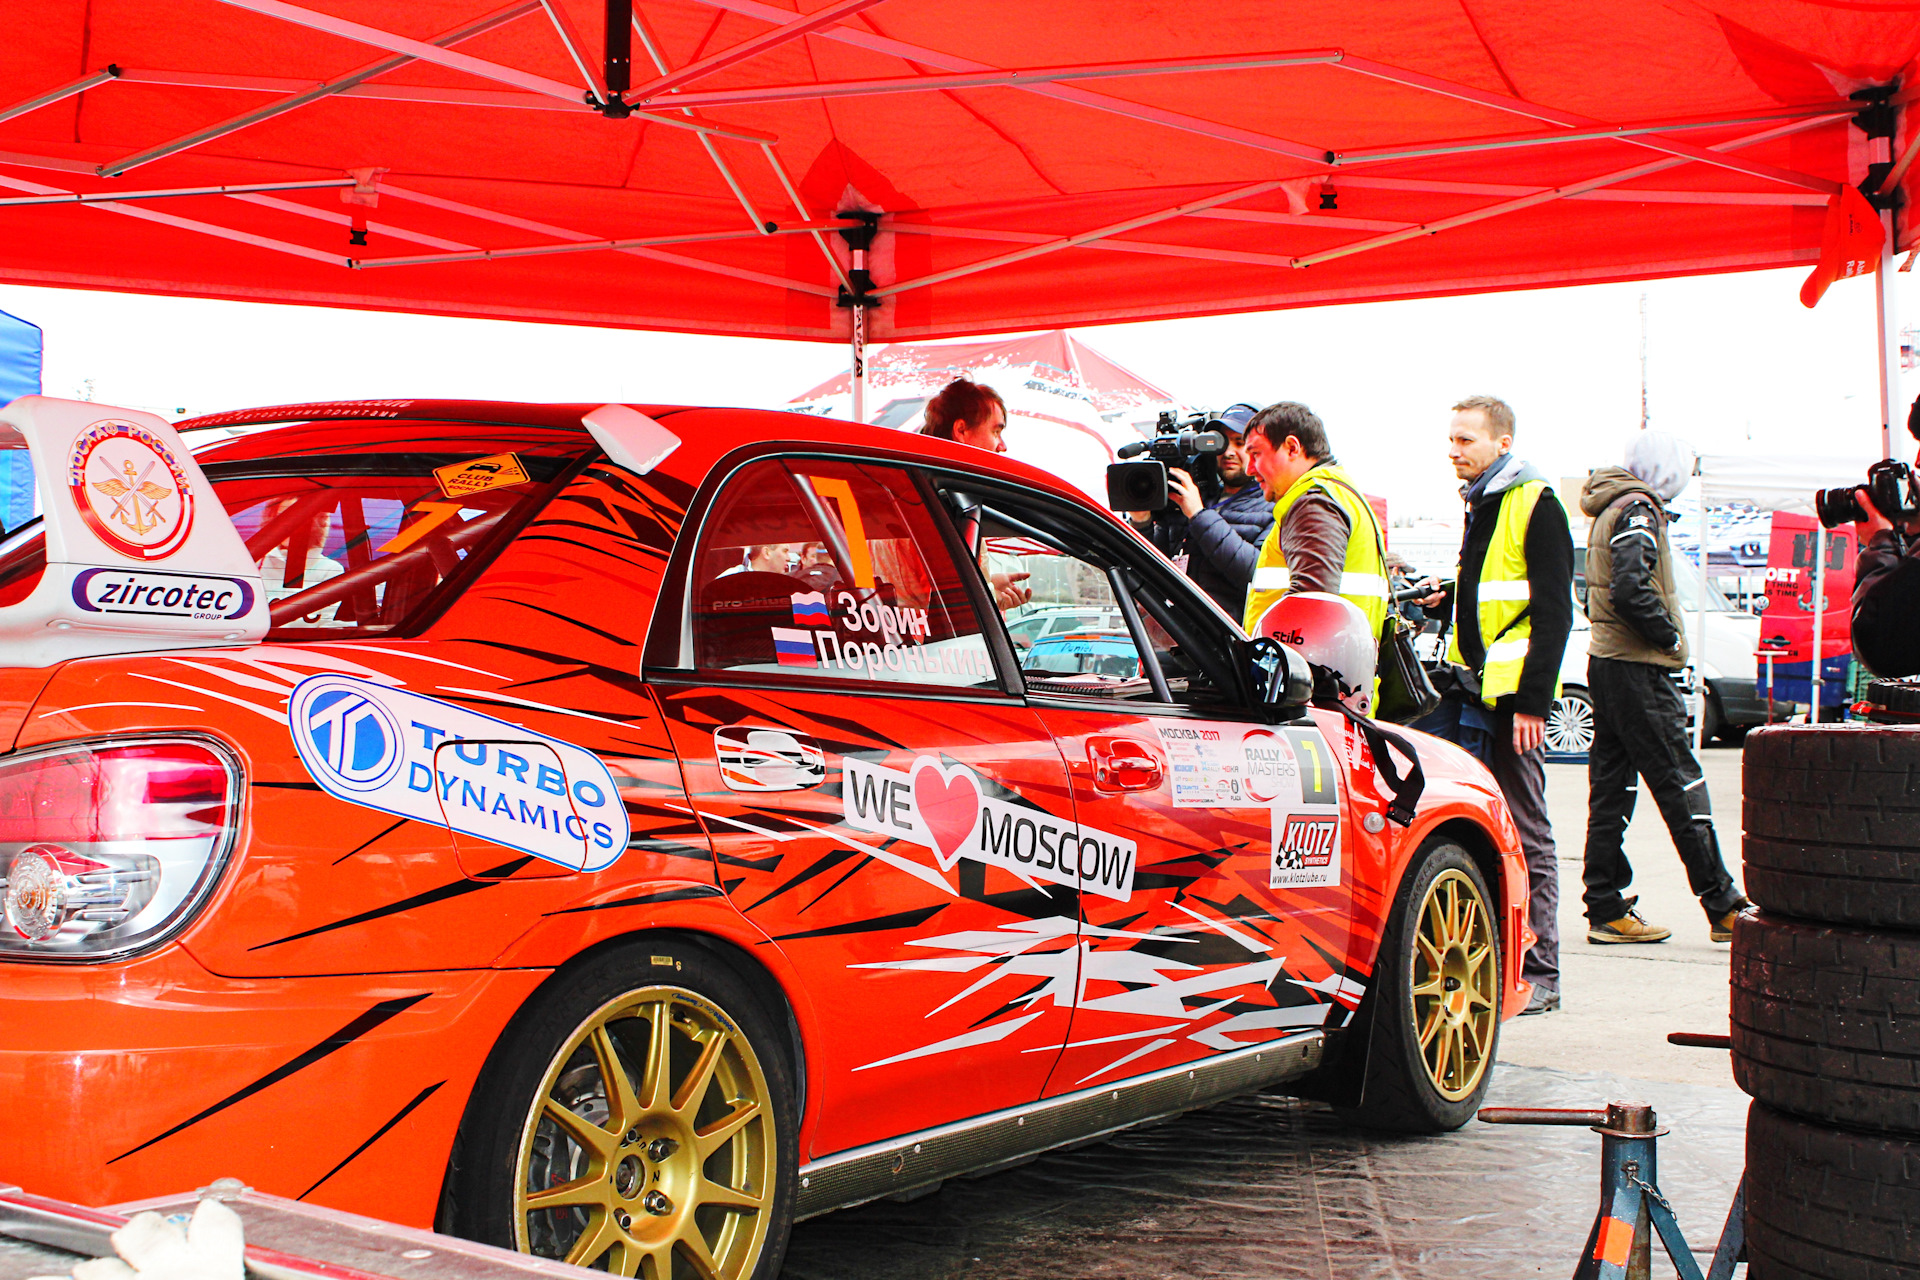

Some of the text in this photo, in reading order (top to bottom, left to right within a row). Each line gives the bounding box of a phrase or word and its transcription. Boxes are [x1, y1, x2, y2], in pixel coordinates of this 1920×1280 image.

[322, 409, 399, 419] принтами
[69, 421, 191, 491] ДОСААФ РОССИИ
[447, 478, 494, 488] RALLY
[457, 473, 495, 482] CLUB
[1772, 581, 1799, 589] THING
[1777, 589, 1798, 597] TIME
[97, 577, 233, 611] zircotec
[193, 612, 222, 620] GROUP
[837, 591, 931, 645] Зорин
[1272, 629, 1305, 646] stilo
[815, 630, 992, 680] Поронькин
[1158, 727, 1221, 741] МОСКВА 2017
[1244, 748, 1280, 762] RALLY
[410, 719, 606, 808] TURBO
[1247, 761, 1296, 777] MASTERS
[407, 760, 615, 850] DYNAMICS
[850, 769, 913, 831] WE
[1283, 820, 1337, 857] KLOTZ
[980, 806, 1132, 891] MOSCOW
[1272, 872, 1327, 884] www.klotzlube.ru
